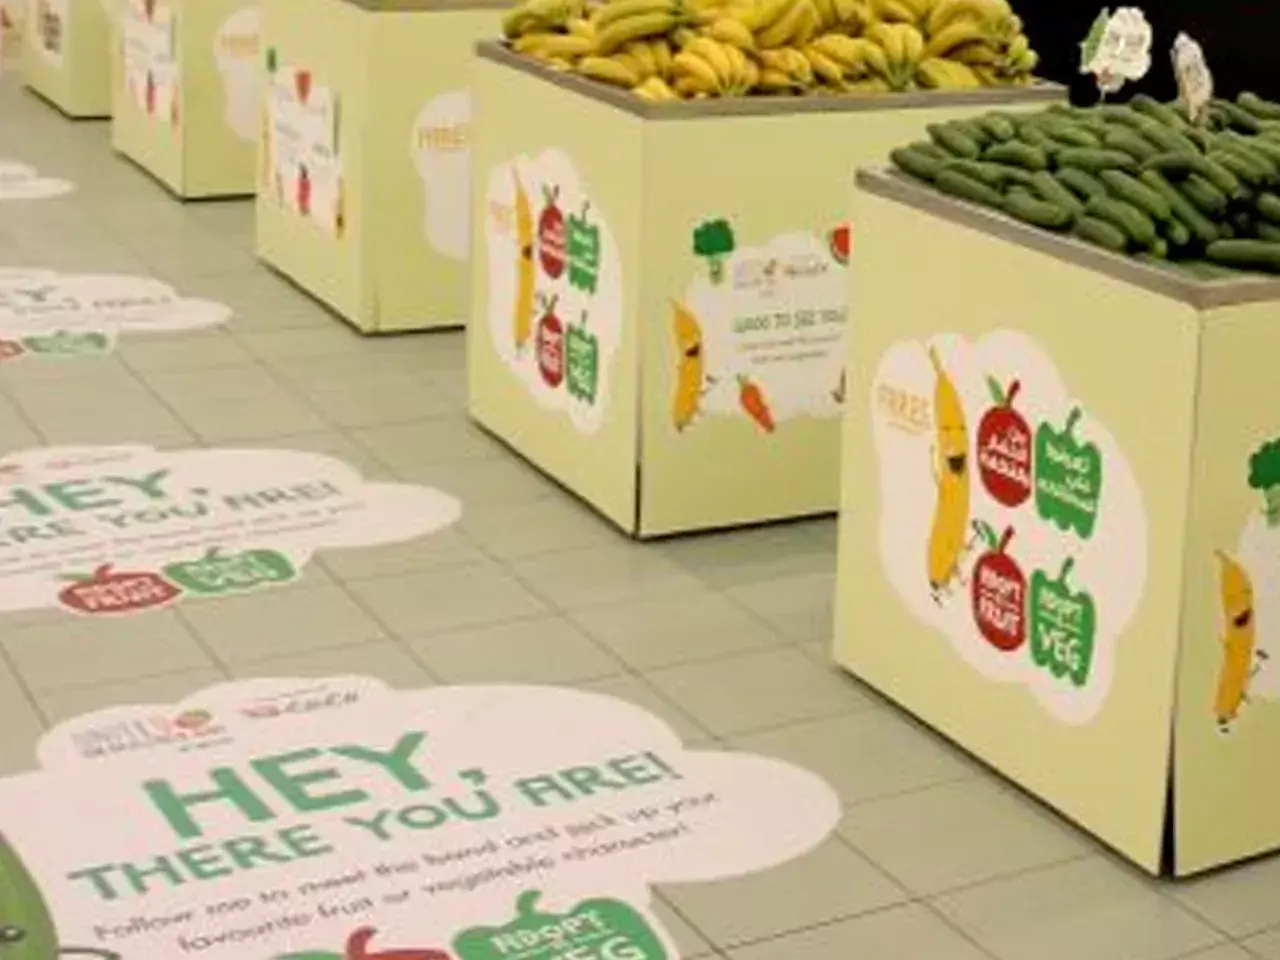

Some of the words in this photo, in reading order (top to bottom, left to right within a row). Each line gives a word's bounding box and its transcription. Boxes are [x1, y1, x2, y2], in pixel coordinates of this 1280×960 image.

[66, 823, 335, 901] THERE
[342, 790, 501, 842] YOU
[512, 750, 684, 807] ARE!
[145, 731, 487, 839] HEY,
